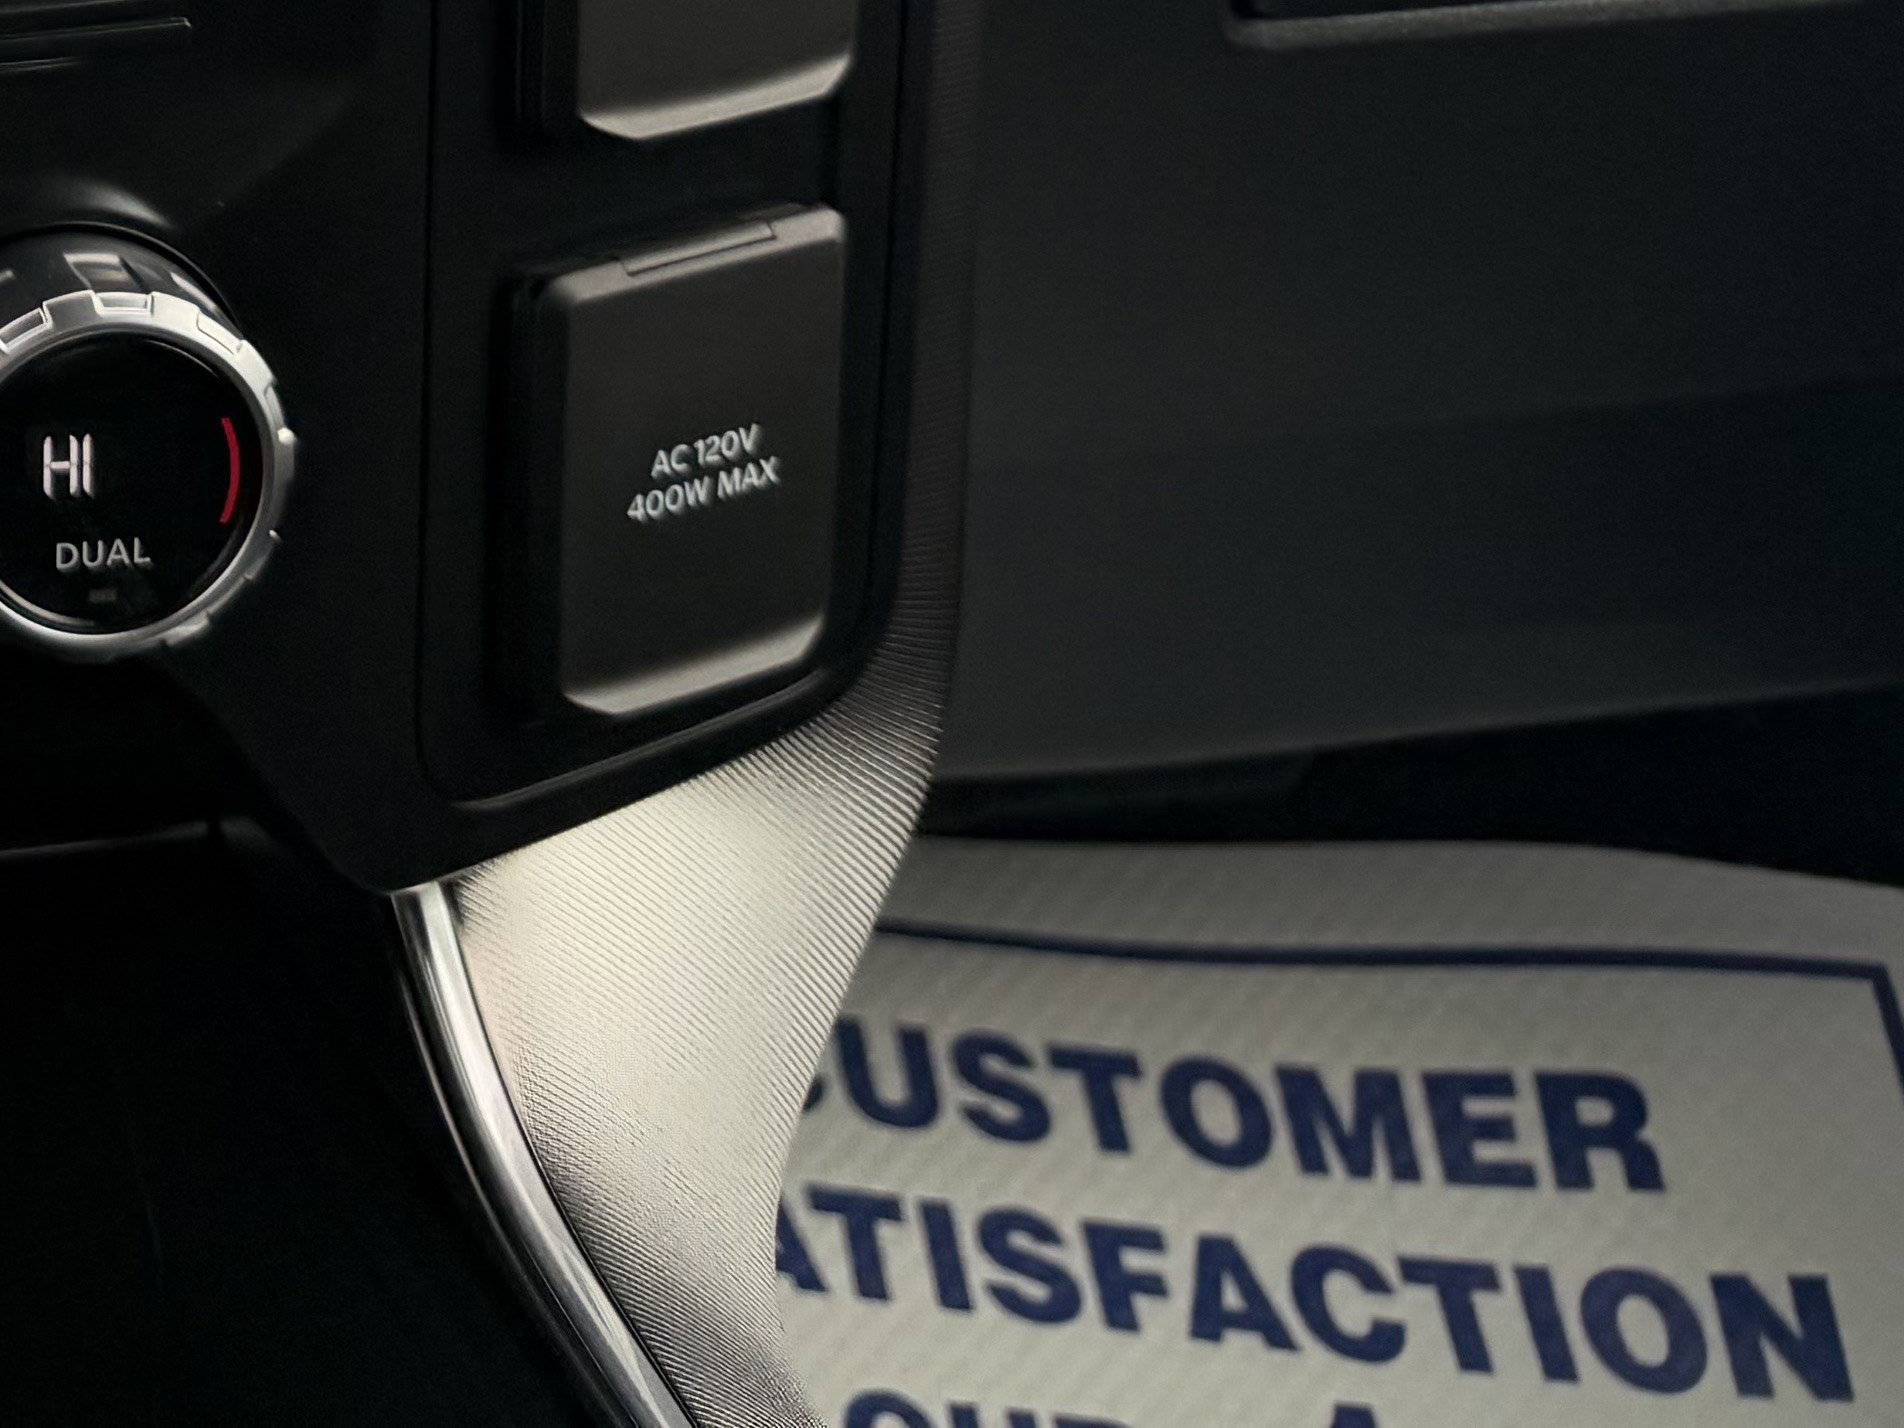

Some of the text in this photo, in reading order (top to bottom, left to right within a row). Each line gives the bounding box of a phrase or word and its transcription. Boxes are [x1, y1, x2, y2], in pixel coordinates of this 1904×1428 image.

[42, 433, 93, 500] HI
[650, 422, 762, 478] AC 120V
[626, 455, 781, 524] 400W MAX
[55, 536, 152, 571] DUAL
[801, 1012, 1667, 1194] USTOMER
